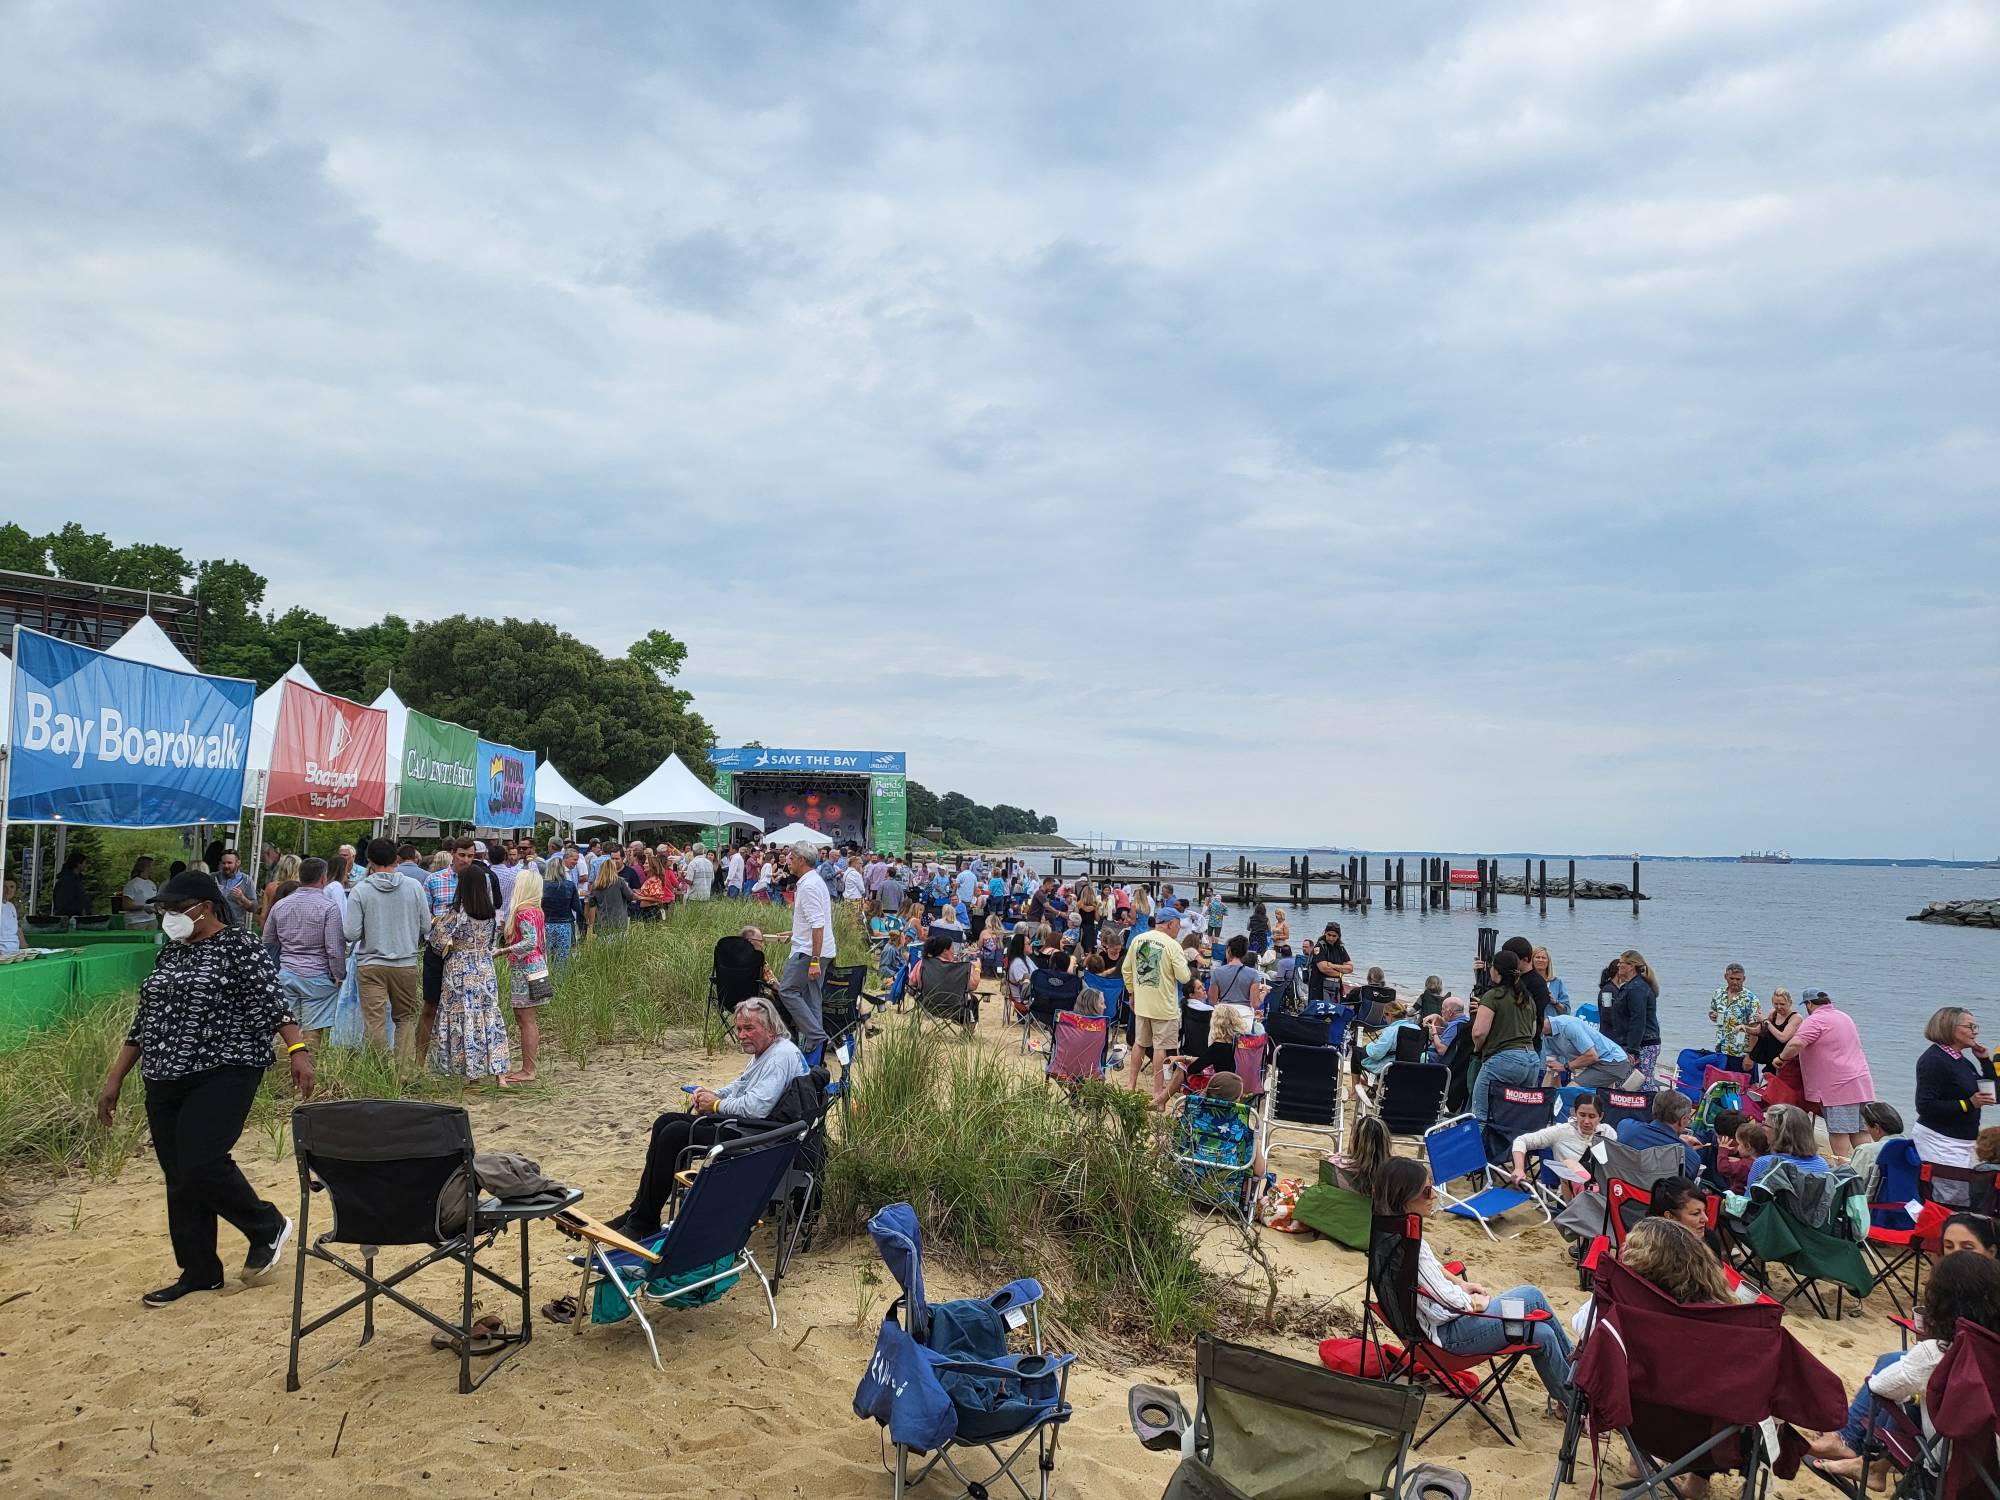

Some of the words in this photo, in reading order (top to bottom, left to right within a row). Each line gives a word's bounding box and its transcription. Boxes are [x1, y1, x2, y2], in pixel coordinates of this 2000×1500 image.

[23, 691, 96, 769] Bay
[97, 707, 241, 769] Boardwalk
[771, 755, 802, 765] SAVE
[806, 755, 830, 765] THE
[833, 756, 858, 767] BAY
[875, 780, 902, 789] Bands
[882, 788, 904, 798] Sand
[1506, 1089, 1543, 1099] MODELL'S
